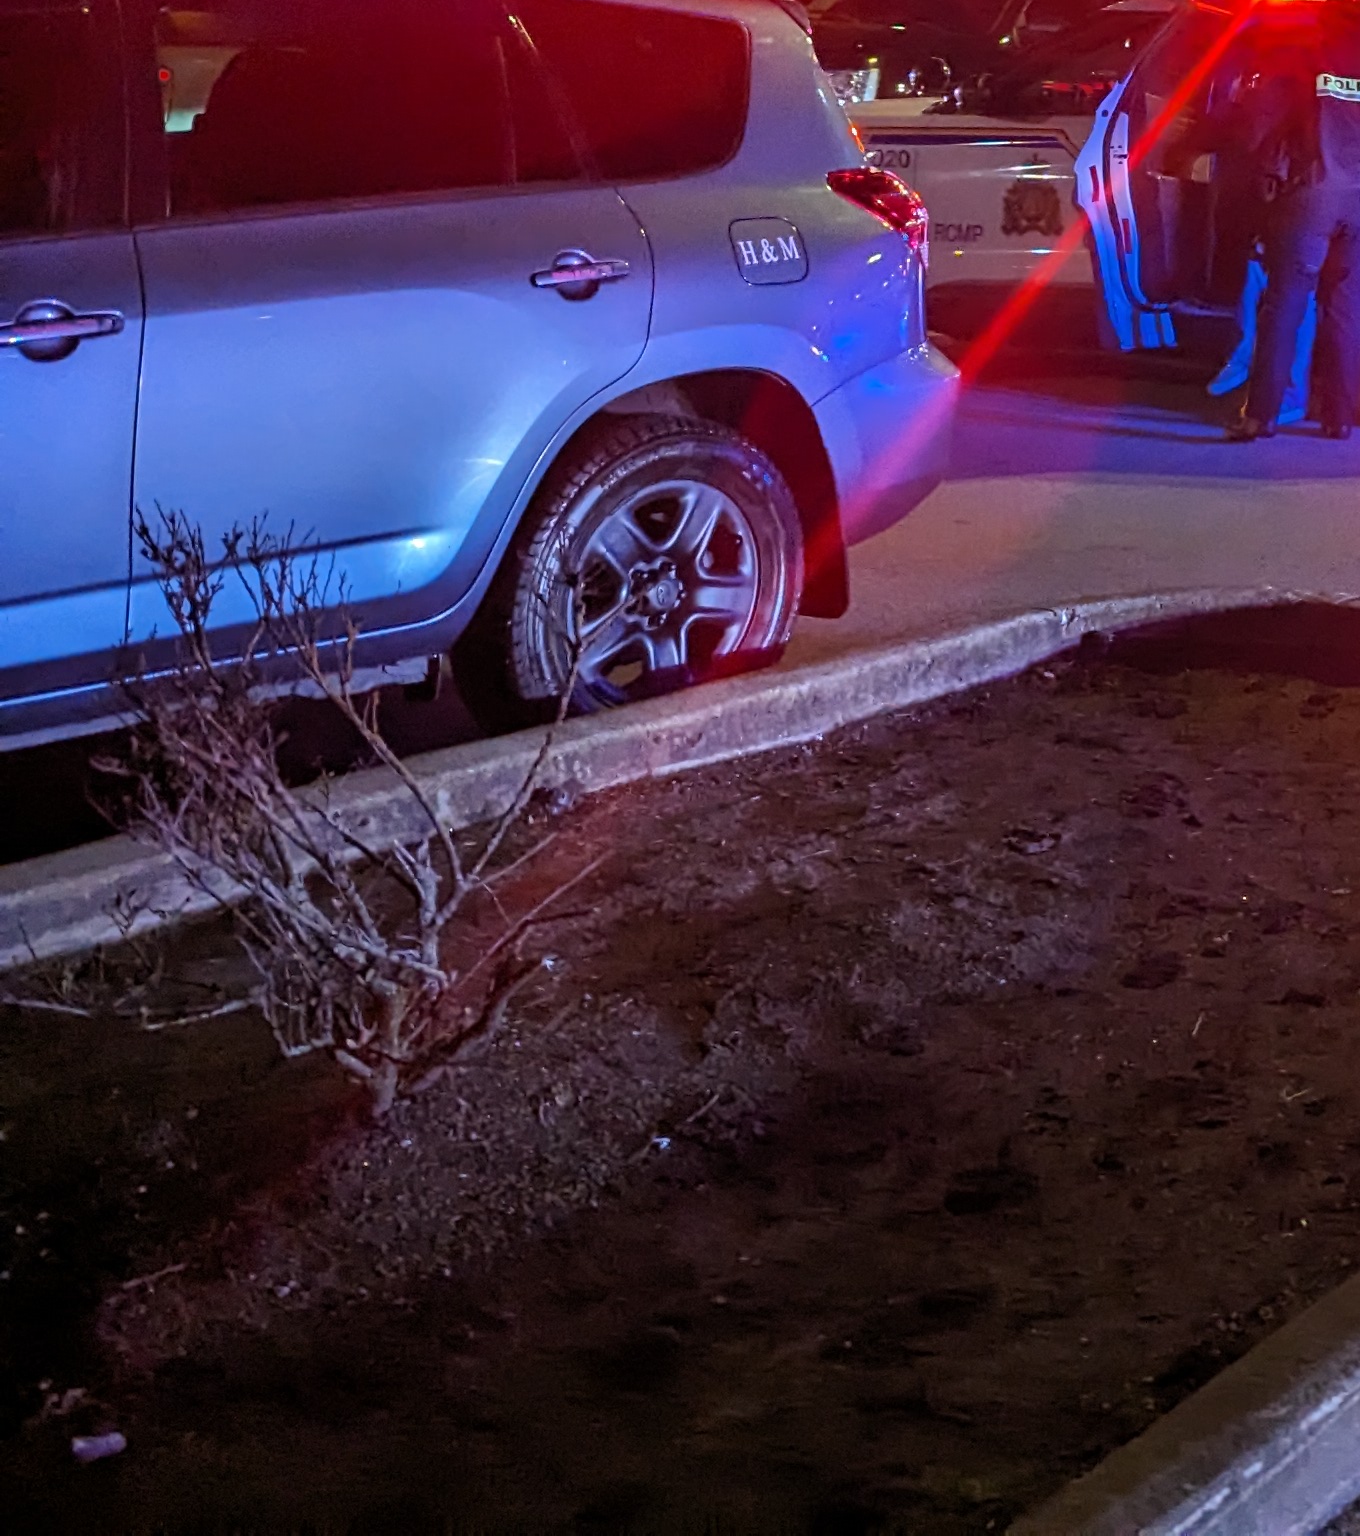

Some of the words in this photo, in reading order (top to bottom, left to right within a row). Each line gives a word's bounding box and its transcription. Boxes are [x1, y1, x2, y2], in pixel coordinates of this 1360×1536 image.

[934, 223, 984, 243] RCMP
[738, 240, 759, 265] H
[761, 238, 779, 263] &
[777, 235, 800, 261] M
